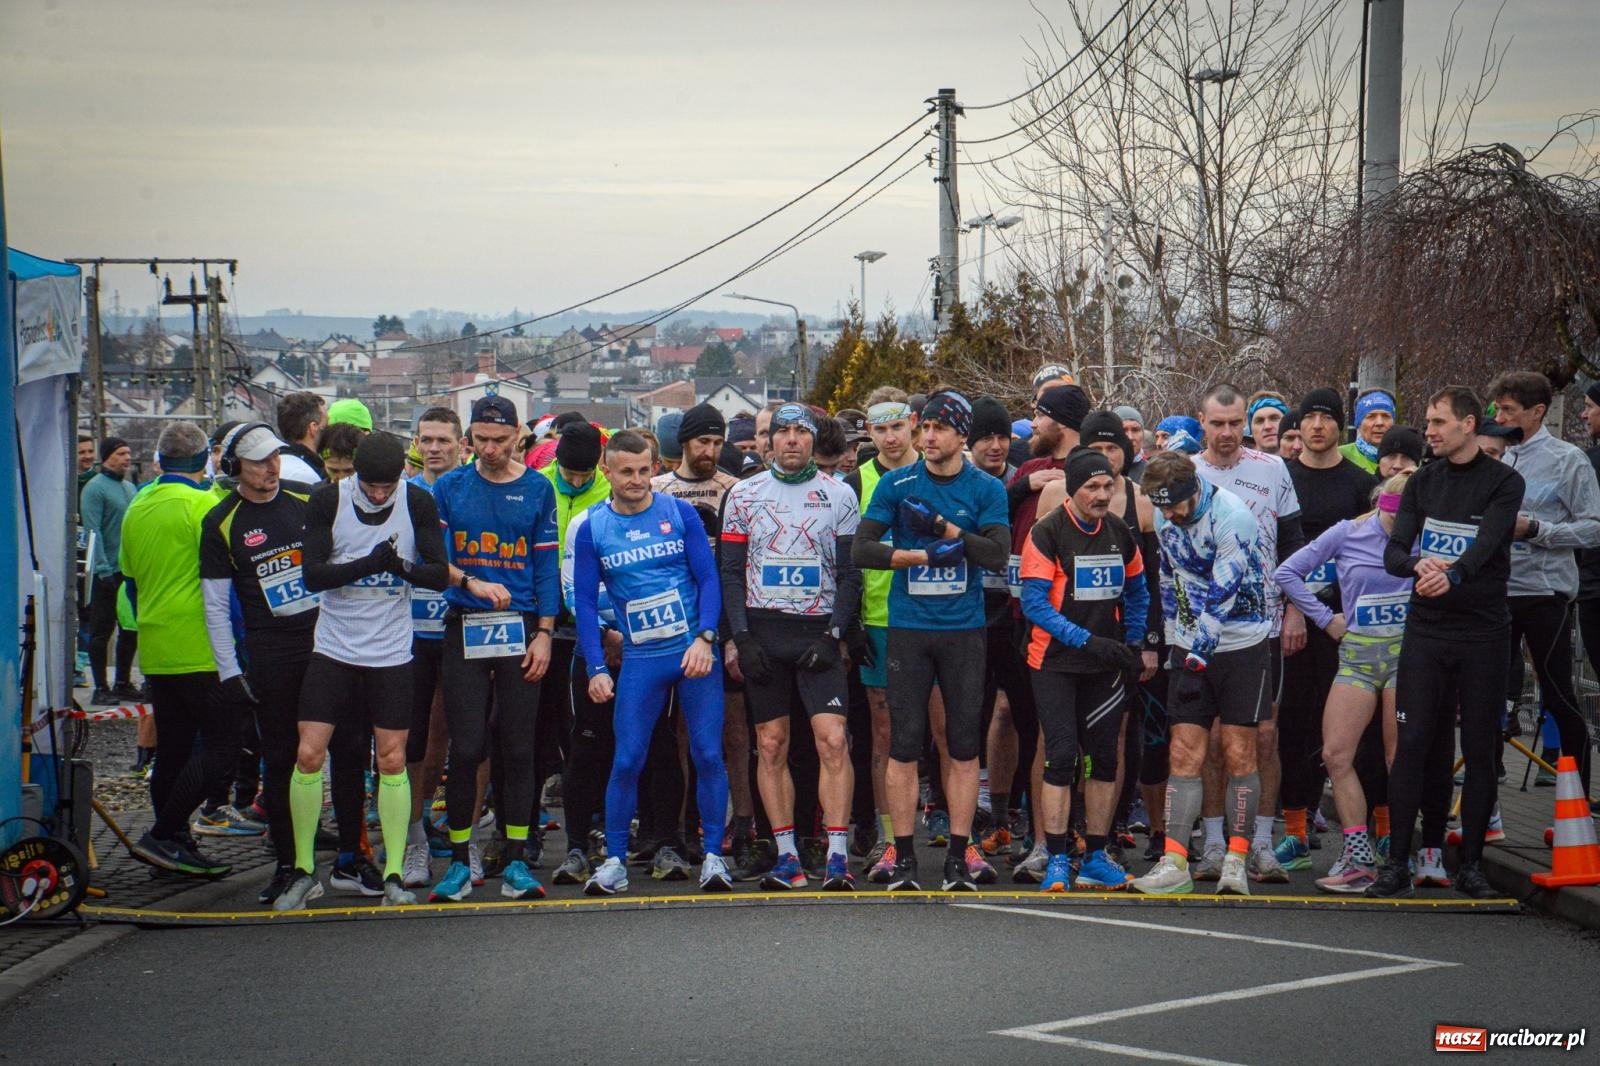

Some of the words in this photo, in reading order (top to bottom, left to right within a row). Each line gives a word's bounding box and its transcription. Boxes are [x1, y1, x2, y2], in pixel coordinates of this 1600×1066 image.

[250, 545, 291, 562] ENERGETYKA
[1428, 532, 1467, 556] 220
[600, 539, 685, 570] RUNNERS
[778, 567, 804, 586] 16
[917, 565, 957, 582] 218
[1010, 568, 1022, 585] 1
[1091, 567, 1112, 586] 31
[276, 580, 313, 604] 15
[637, 604, 676, 630] 114
[1366, 605, 1407, 625] 153
[481, 624, 509, 645] 74
